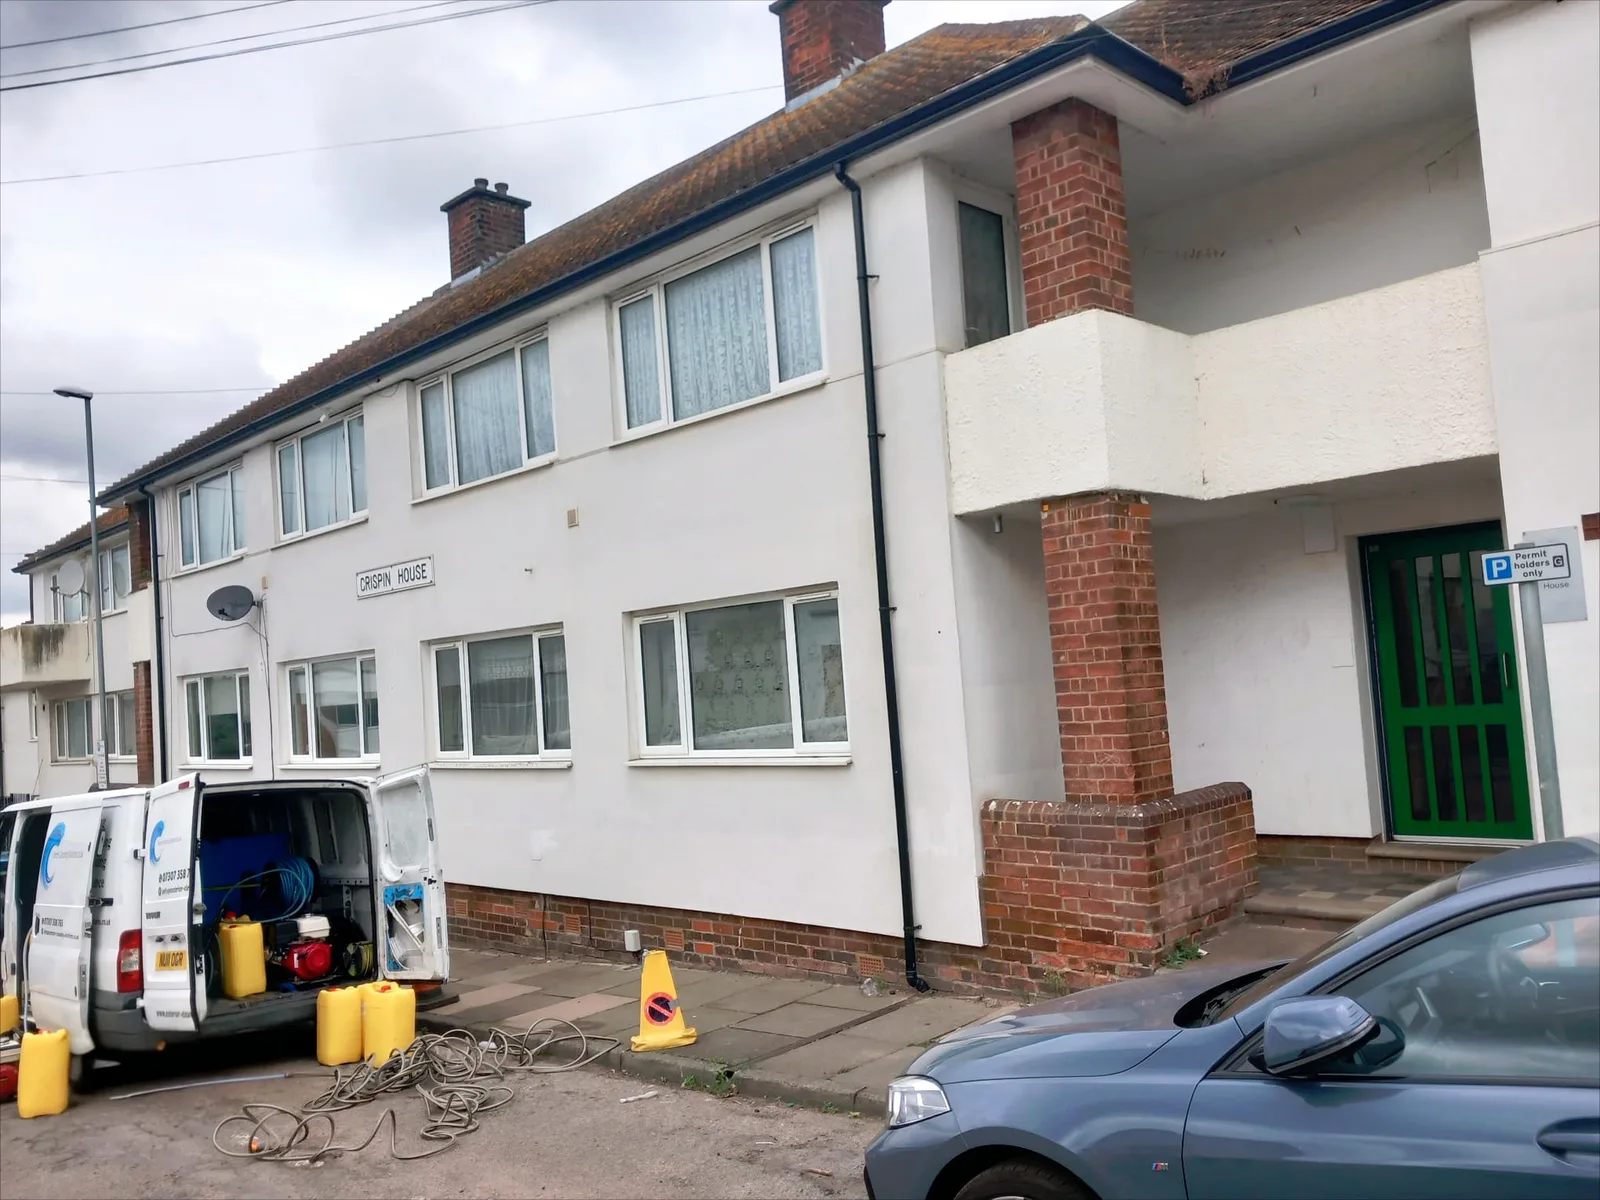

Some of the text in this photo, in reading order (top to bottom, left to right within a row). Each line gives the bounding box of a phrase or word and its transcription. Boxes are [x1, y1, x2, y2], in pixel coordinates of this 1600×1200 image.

[1515, 550, 1548, 560] Permit
[1492, 559, 1508, 578] P
[1514, 556, 1563, 570] holders G
[360, 563, 427, 592] CRISPIN HOUSE
[1522, 569, 1543, 578] only
[1543, 582, 1570, 590] House
